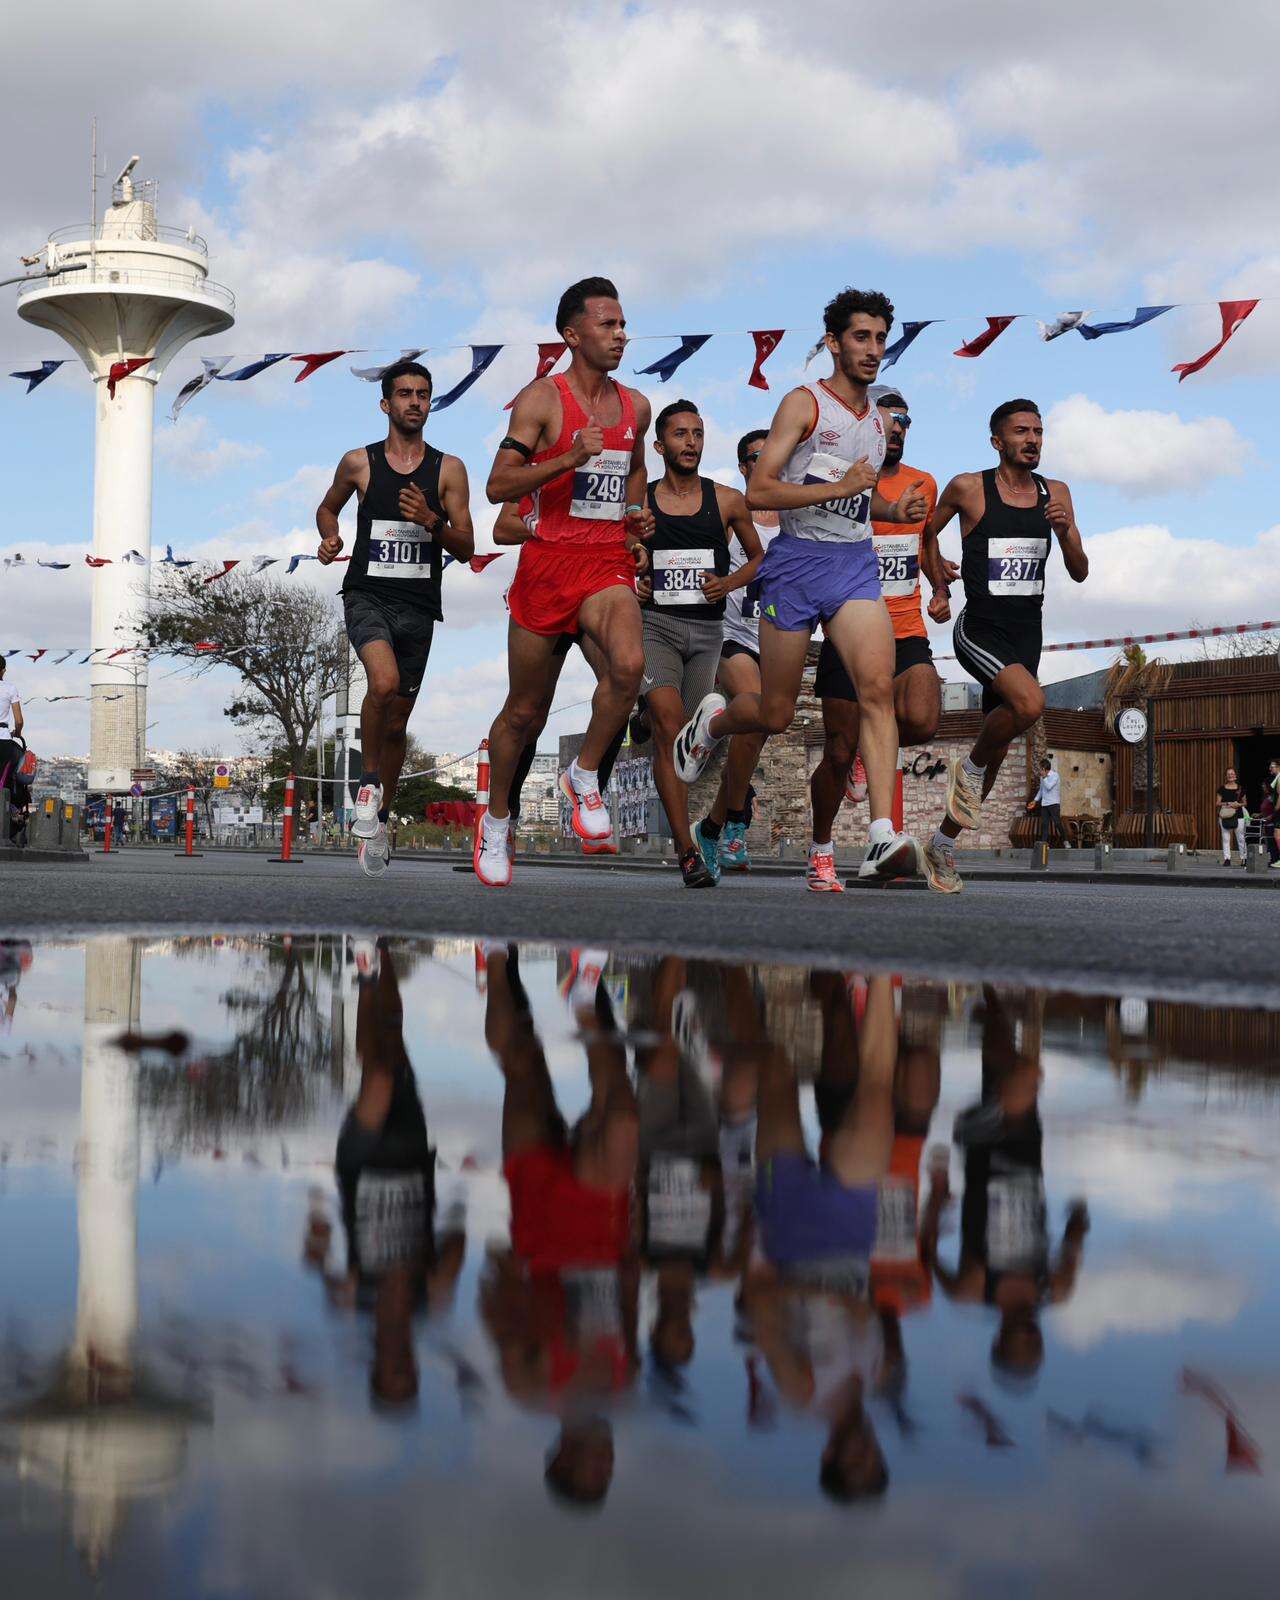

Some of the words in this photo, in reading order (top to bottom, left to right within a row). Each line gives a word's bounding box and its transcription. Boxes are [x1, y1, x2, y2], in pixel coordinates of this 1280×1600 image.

[379, 540, 421, 563] 3101
[664, 569, 706, 590] 3845
[1000, 558, 1040, 580] 2377
